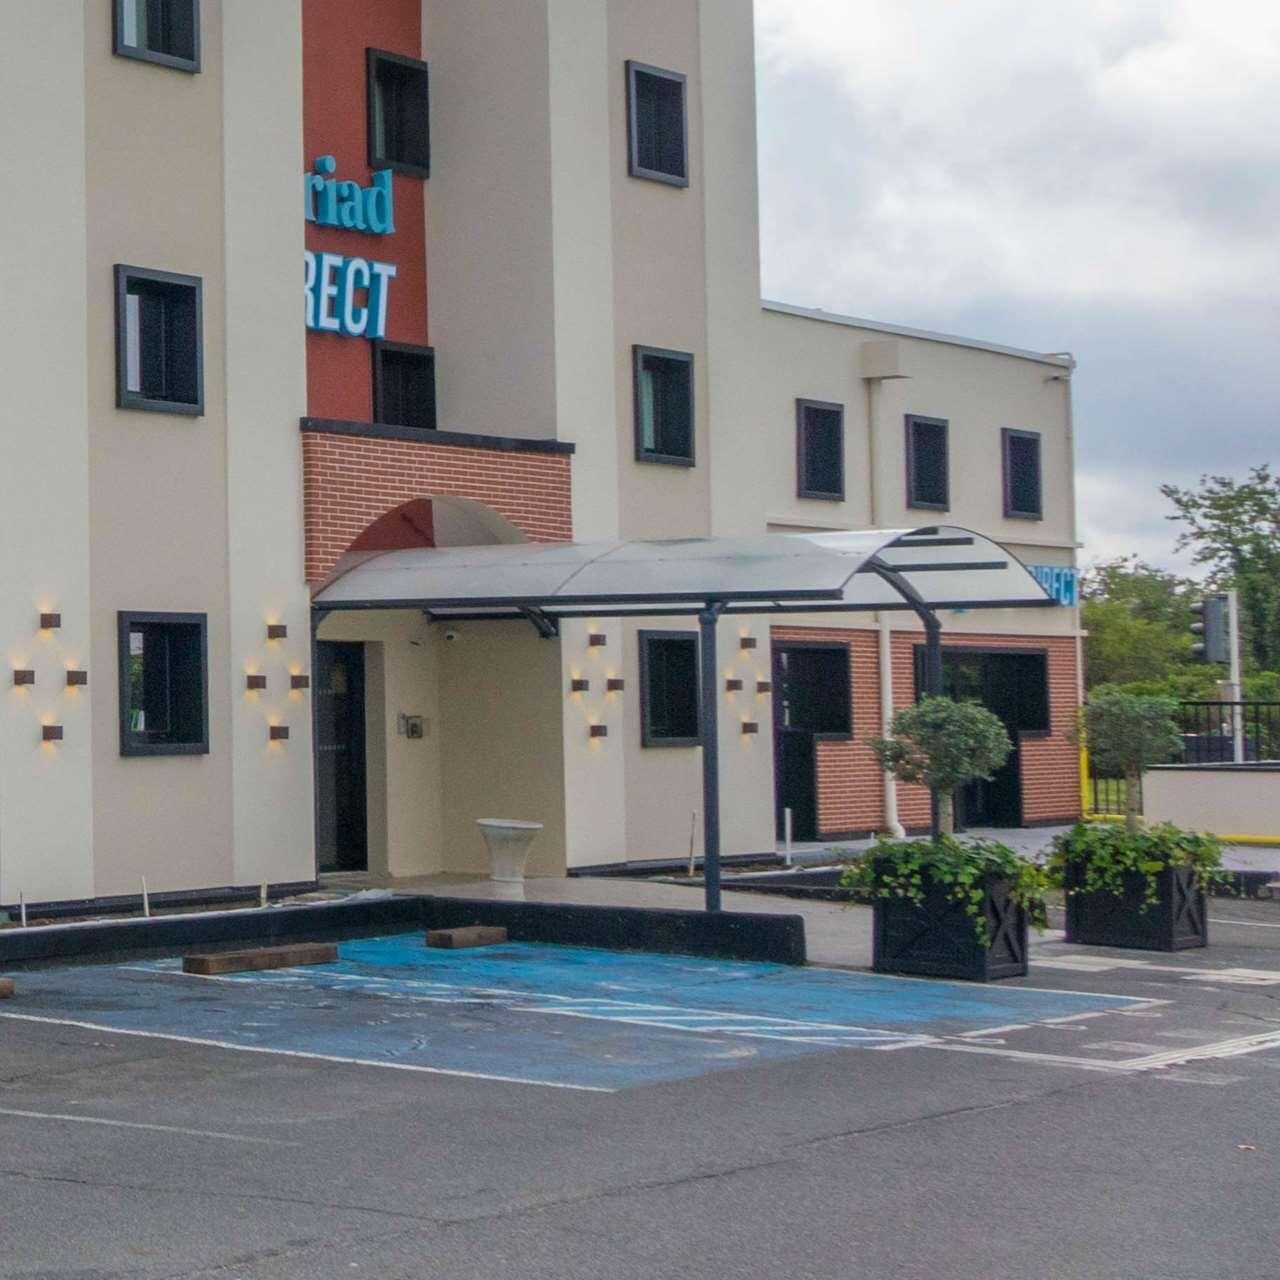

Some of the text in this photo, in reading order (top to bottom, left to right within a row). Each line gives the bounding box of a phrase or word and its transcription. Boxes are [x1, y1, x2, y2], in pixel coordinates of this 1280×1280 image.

[304, 155, 395, 234] riad
[304, 250, 396, 339] RECT
[1025, 565, 1080, 607] RECT
